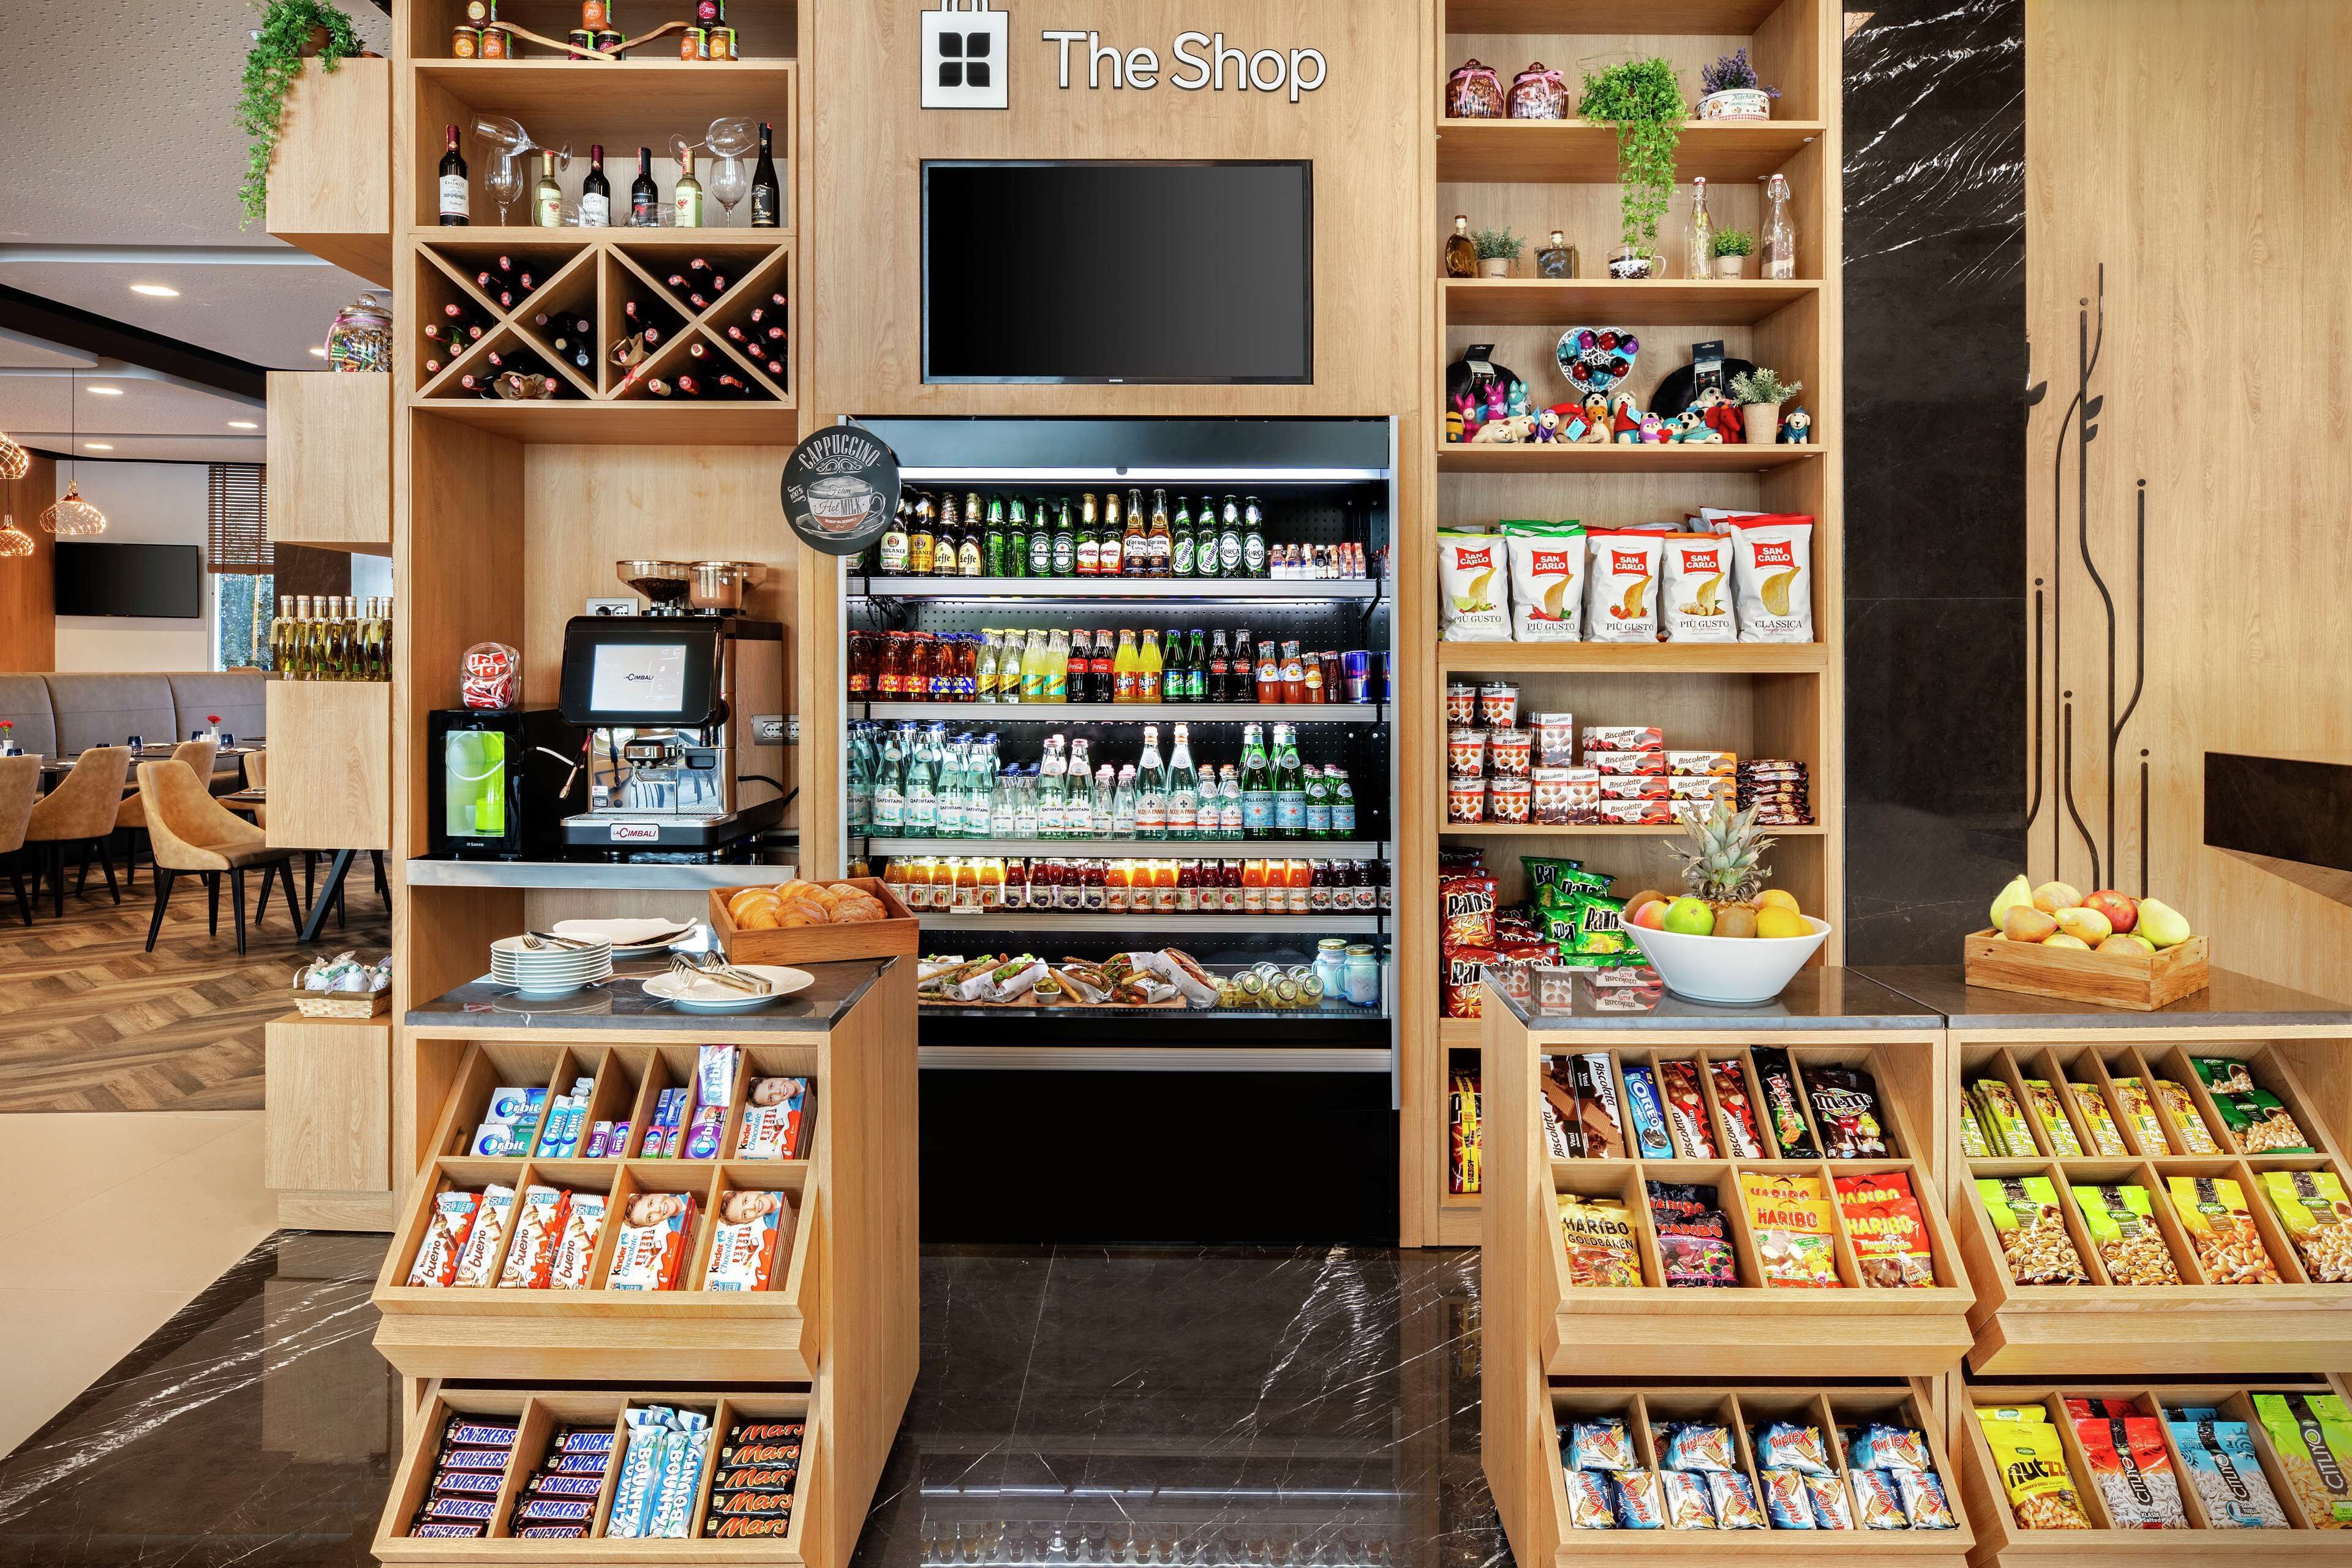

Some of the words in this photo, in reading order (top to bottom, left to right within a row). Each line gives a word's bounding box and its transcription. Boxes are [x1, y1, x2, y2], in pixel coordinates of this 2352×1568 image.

[1042, 30, 1159, 90] The
[1170, 31, 1327, 104] Shop
[798, 434, 881, 470] CAPPUCCINO
[790, 486, 804, 500] 100%
[827, 484, 852, 496] Foam
[815, 500, 839, 514] Hot
[840, 498, 862, 516] MILK
[935, 553, 951, 564] Leffe
[960, 553, 976, 565] Leffe
[1175, 545, 1191, 569] TUBORG
[1202, 543, 1219, 569] TUBORG
[1221, 548, 1240, 556] KORÇA
[1762, 546, 1783, 555] SAN
[1615, 562, 1645, 571] CARLO
[1527, 622, 1545, 630] PIÙ
[1607, 620, 1623, 630] PIÙ
[1680, 618, 1696, 628] PIÙ
[1755, 620, 1802, 628] CLASSICA
[1604, 729, 1636, 739] Biscolata
[1605, 754, 1637, 764] Biscolata
[1678, 755, 1710, 764] Biscolata
[1609, 778, 1641, 789] Biscolata
[1677, 779, 1709, 789] Biscolata
[1610, 803, 1642, 813] Biscolata
[620, 827, 656, 838] CIMBALI
[1455, 914, 1485, 929] Rolls
[1593, 1061, 1616, 1107] Biscolata
[1632, 1081, 1660, 1126] OREO
[1766, 1074, 1795, 1119] Biskrem
[495, 1096, 541, 1118] Orbit
[541, 1114, 563, 1146] Orbit
[560, 1113, 579, 1145] Orbit
[614, 1125, 630, 1152] Orbit
[690, 1115, 718, 1159] Orbit
[748, 1113, 762, 1151] Chocolate
[1542, 1110, 1566, 1158] Biscolata
[1672, 1112, 1697, 1158] Biscolata
[479, 1134, 526, 1156] Orbit
[586, 1134, 603, 1158] Orbit
[2200, 1205, 2226, 1214] peyman
[2302, 1199, 2328, 1207] peyman
[1562, 1217, 1630, 1235] HARIBO
[1757, 1207, 1817, 1229] HARIBO
[1845, 1215, 1913, 1235] HARIBO
[1656, 1224, 1723, 1237] HARIBO
[469, 1229, 486, 1268] bueno
[513, 1229, 529, 1266] bueno
[1568, 1234, 1634, 1250] GOLDBÄREN
[422, 1240, 441, 1278] bueno
[622, 1235, 638, 1277] Chocolate
[720, 1232, 734, 1274] Chocolate
[457, 1427, 517, 1443] SNICKERS
[739, 1424, 805, 1443] Mars
[448, 1452, 509, 1467] SNICKERS
[731, 1444, 799, 1466] Mars
[441, 1474, 503, 1491] SNICKERS
[725, 1469, 796, 1490] Mars
[2008, 1458, 2066, 1488] nutzz
[541, 1477, 602, 1494] SNICKERS
[625, 1448, 652, 1528] BOUNTY
[654, 1449, 681, 1526] BOUNTY
[671, 1447, 701, 1521] BOUNTY
[435, 1499, 495, 1517] SNICKERS
[528, 1501, 590, 1518] SNICKERS
[723, 1493, 794, 1515] Mars
